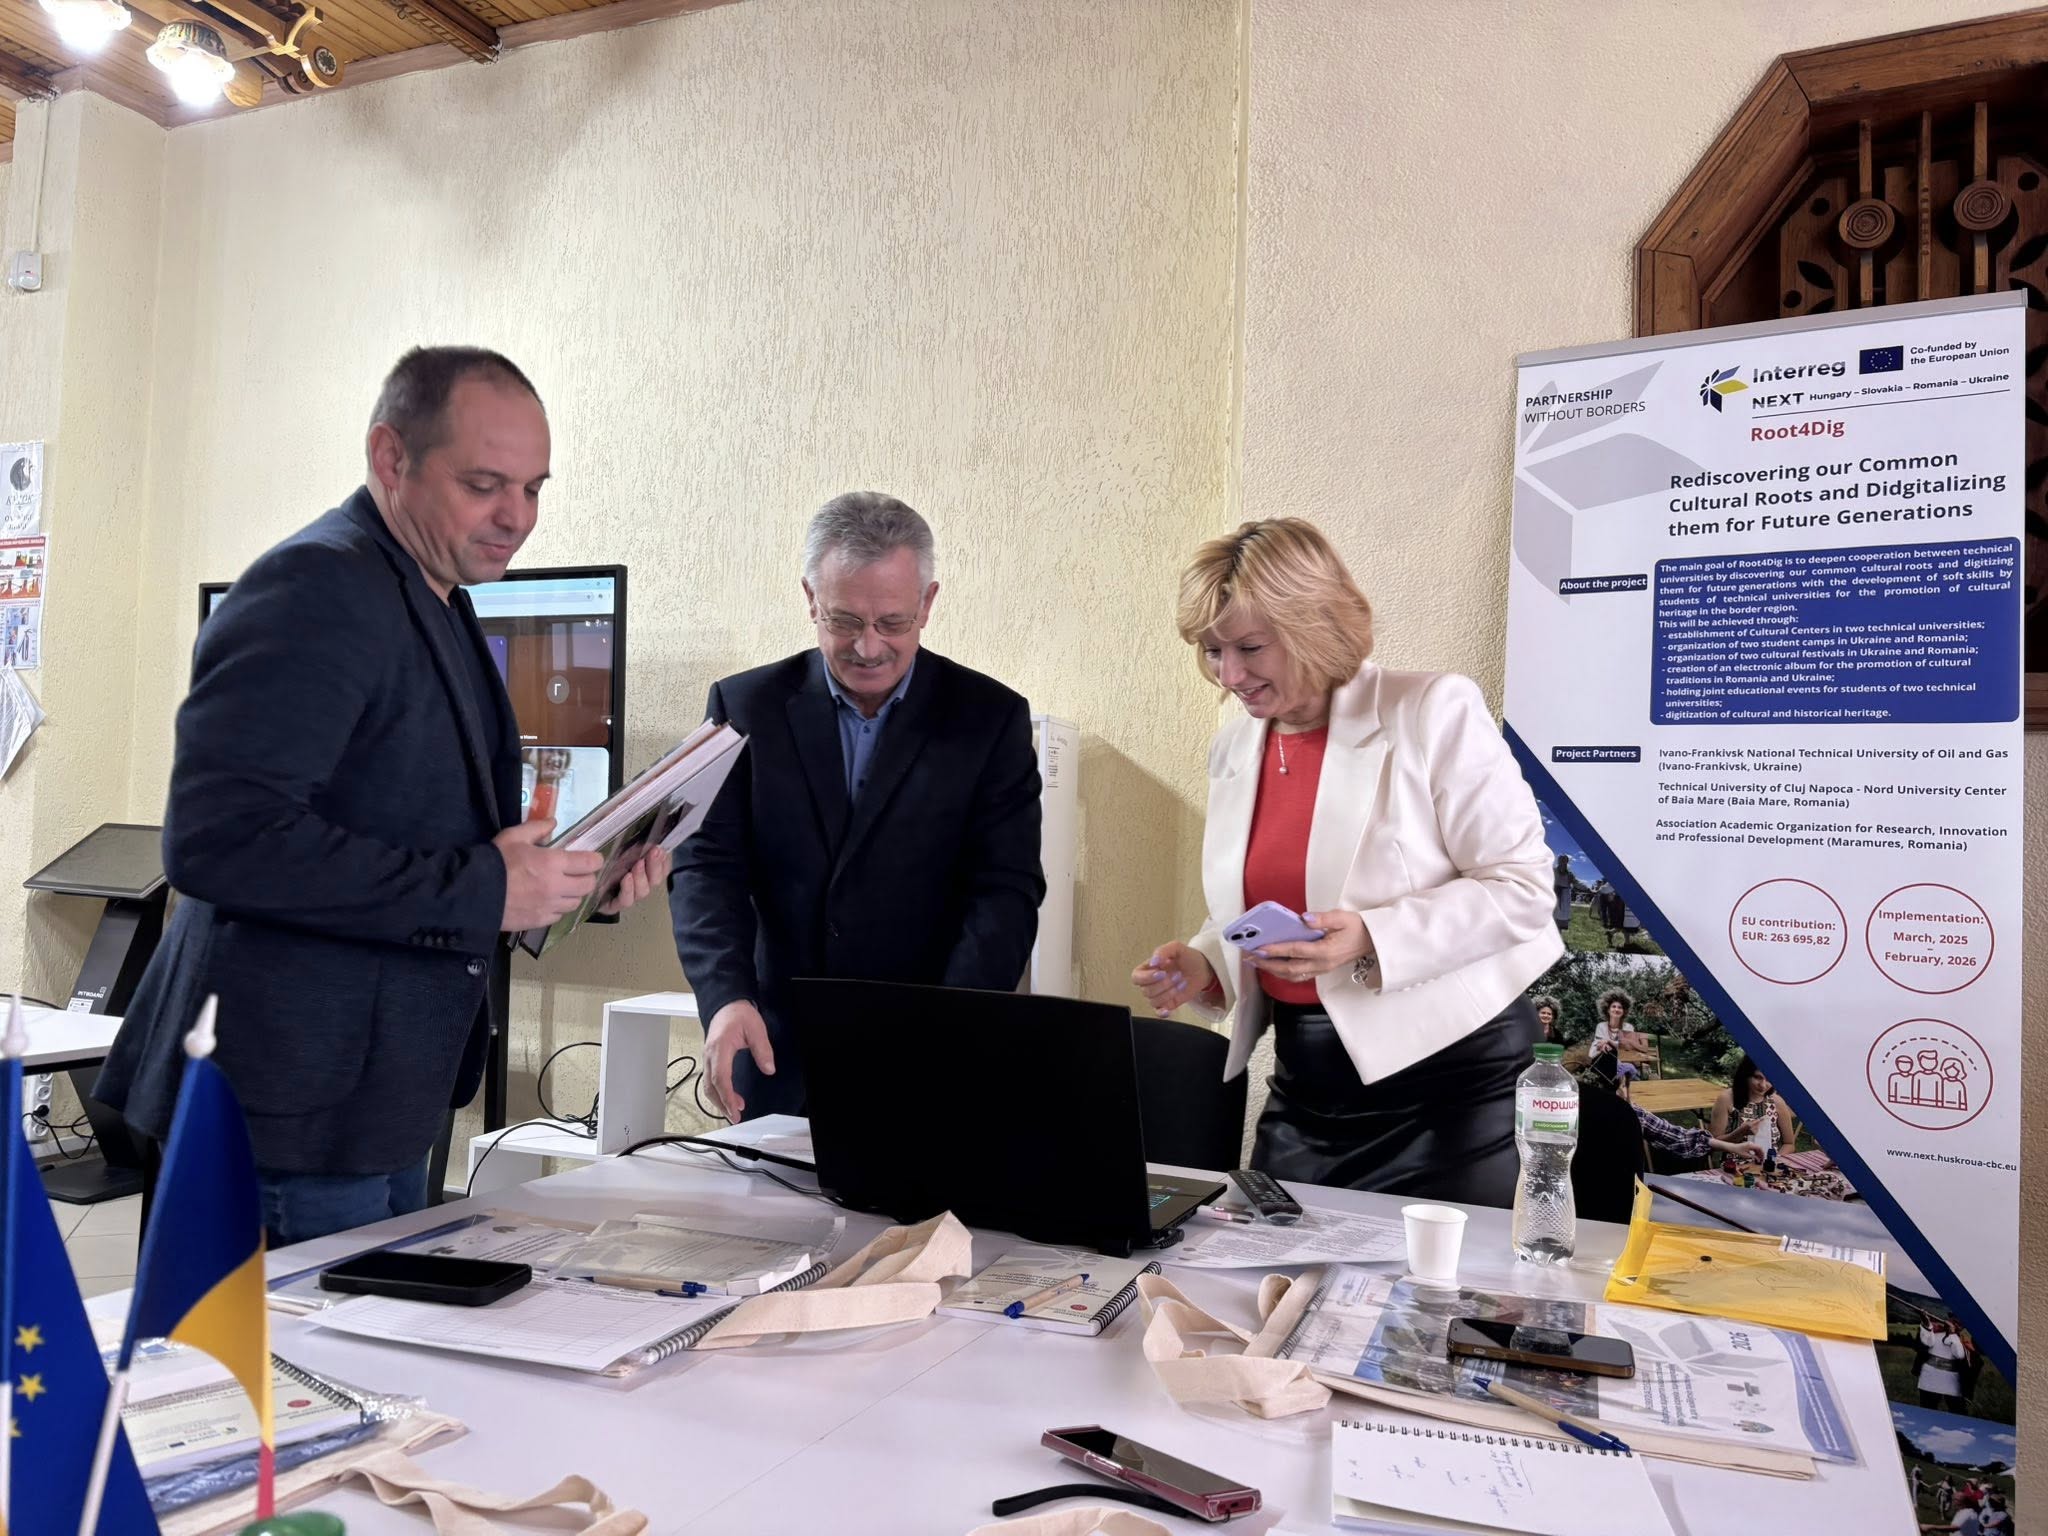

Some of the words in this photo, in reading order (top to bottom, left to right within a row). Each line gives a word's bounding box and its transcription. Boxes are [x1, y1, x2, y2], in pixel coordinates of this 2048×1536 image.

[1910, 342, 1961, 355] Co-funded
[1964, 341, 1977, 350] by
[1910, 356, 1925, 365] the
[1929, 351, 1976, 363] European
[1979, 347, 2010, 357] Union
[1753, 362, 1846, 383] Interreg
[1809, 390, 1851, 401] Hungary
[1861, 384, 1902, 395] Slovakia
[1913, 378, 1958, 390] Romania
[1969, 373, 2010, 384] Ukraine
[1525, 390, 1613, 407] PARTNERSHIP
[1752, 392, 1804, 409] NEXT
[1524, 408, 1582, 423] WITHOUT
[1586, 402, 1646, 417] BORDERS
[1751, 421, 1845, 442] Root4Dig
[1670, 466, 1809, 489] Rediscovering
[1816, 464, 1852, 477] our
[1859, 455, 1959, 474] Common
[1669, 493, 1747, 512] Cultural
[1755, 489, 1812, 506] Roots
[1819, 485, 1858, 501] and
[1867, 475, 2006, 499] Didgitalizing
[1669, 520, 1719, 536] them
[1726, 518, 1754, 532] for
[1762, 514, 1829, 530] Future
[1837, 504, 1973, 525] Generations
[1660, 564, 1677, 572] The
[1679, 562, 1702, 571] main
[1704, 561, 1724, 571] goal
[1726, 560, 1736, 568] of
[1739, 558, 1782, 568] Root4Dig
[1785, 557, 1792, 565] is
[1795, 556, 1805, 564] to
[1808, 556, 1845, 564] deepen
[1848, 550, 1910, 562] cooperation
[1914, 548, 1960, 557] between
[1963, 544, 2013, 554] technical
[1660, 574, 1713, 584] universities
[1716, 573, 1727, 582] by
[1729, 570, 1784, 580] discovering
[1811, 568, 1855, 576] common
[1861, 563, 1901, 573] cultural
[1905, 562, 1932, 571] roots
[1938, 560, 1958, 569] and
[1964, 558, 2014, 569] digitizing
[1560, 580, 1590, 590] About
[1592, 580, 1608, 588] the
[1611, 578, 1647, 589] project
[1659, 586, 1684, 595] them
[1688, 585, 1702, 593] for
[1706, 584, 1736, 592] future
[1738, 581, 1797, 592] generations
[1801, 579, 1824, 588] with
[1829, 578, 1847, 586] the
[1851, 574, 1921, 585] development
[1926, 573, 1937, 581] of
[1942, 572, 1963, 581] soft
[1966, 570, 1994, 579] skills
[1999, 570, 2013, 579] by
[1659, 620, 1677, 628] This
[1679, 619, 1695, 627] will
[1698, 618, 1709, 626] be
[1711, 617, 1753, 626] achieved
[1668, 629, 1734, 639] establishment
[1737, 629, 1747, 637] of
[1749, 628, 1788, 636] Cultural
[1791, 627, 1829, 635] Centers
[1832, 626, 1842, 634] in
[1867, 623, 1915, 633] technical
[1667, 652, 1725, 663] organization
[1728, 652, 1738, 660] of
[1740, 652, 1758, 660] two
[1761, 650, 1799, 659] cultural
[1802, 650, 1844, 658] festivals
[1847, 649, 1856, 657] in
[1860, 648, 1901, 657] Ukraine
[1904, 648, 1924, 656] and
[1666, 687, 1700, 697] holding
[1702, 687, 1724, 696] joint
[1727, 686, 1784, 694] educational
[1787, 685, 1820, 694] events
[1823, 685, 1838, 693] for
[1841, 684, 1886, 693] students
[1889, 684, 1900, 692] of
[1903, 684, 1923, 692] two
[1926, 683, 1976, 692] technical
[1665, 710, 1717, 720] digitization
[1720, 710, 1730, 718] of
[1732, 710, 1769, 718] cultural
[1772, 710, 1791, 718] and
[1794, 709, 1841, 717] historical
[1844, 709, 1892, 718] heritage.
[1556, 750, 1590, 759] Project
[1593, 750, 1637, 758] Partners
[1659, 749, 1743, 758] Ivano-Frankivsk
[1747, 749, 1795, 758] National
[1799, 749, 1852, 758] Technical
[1856, 749, 1918, 760] University
[1922, 749, 1934, 758] of
[1937, 749, 1954, 758] Oil
[1958, 749, 1981, 758] and
[1986, 749, 2009, 758] Gas
[1658, 762, 1749, 772] (Ivano-Frankivsk,
[1753, 763, 1803, 773] Ukraine)
[1658, 782, 1706, 791] Technical
[1710, 783, 1766, 794] University
[1770, 784, 1780, 792] of
[1784, 784, 1805, 795] Cluj
[1809, 784, 1852, 795] Napoca
[1864, 785, 1893, 794] Nord
[1897, 785, 1960, 797] University
[1964, 786, 2007, 795] Center
[1658, 796, 1668, 804] of
[1697, 796, 1724, 805] Mare
[1758, 798, 1789, 808] Mare,
[1794, 798, 1850, 809] Romania)
[1656, 819, 1716, 829] Association
[1719, 820, 1772, 830] Academic
[1776, 822, 1851, 833] Organization
[1855, 824, 1872, 833] for
[1876, 824, 1934, 836] Research,
[1939, 826, 2008, 836] Innovation
[1656, 832, 1675, 841] and
[1678, 833, 1744, 843] Professional
[1748, 835, 1823, 847] Development
[1908, 840, 1968, 852] Romania)
[1741, 917, 1755, 926] EU
[1759, 918, 1836, 931] contribution:
[1878, 910, 1984, 924] Implementation:
[1742, 931, 1767, 941] EUR:
[1770, 933, 1790, 943] 263
[1793, 934, 1830, 946] 695,82
[1893, 932, 1935, 945] March,
[1939, 934, 1968, 945] 2025
[1884, 952, 1943, 966] February,
[1947, 956, 1977, 966] 2026
[1886, 1150, 2017, 1171] www.next.huskroua-cbc.eu
